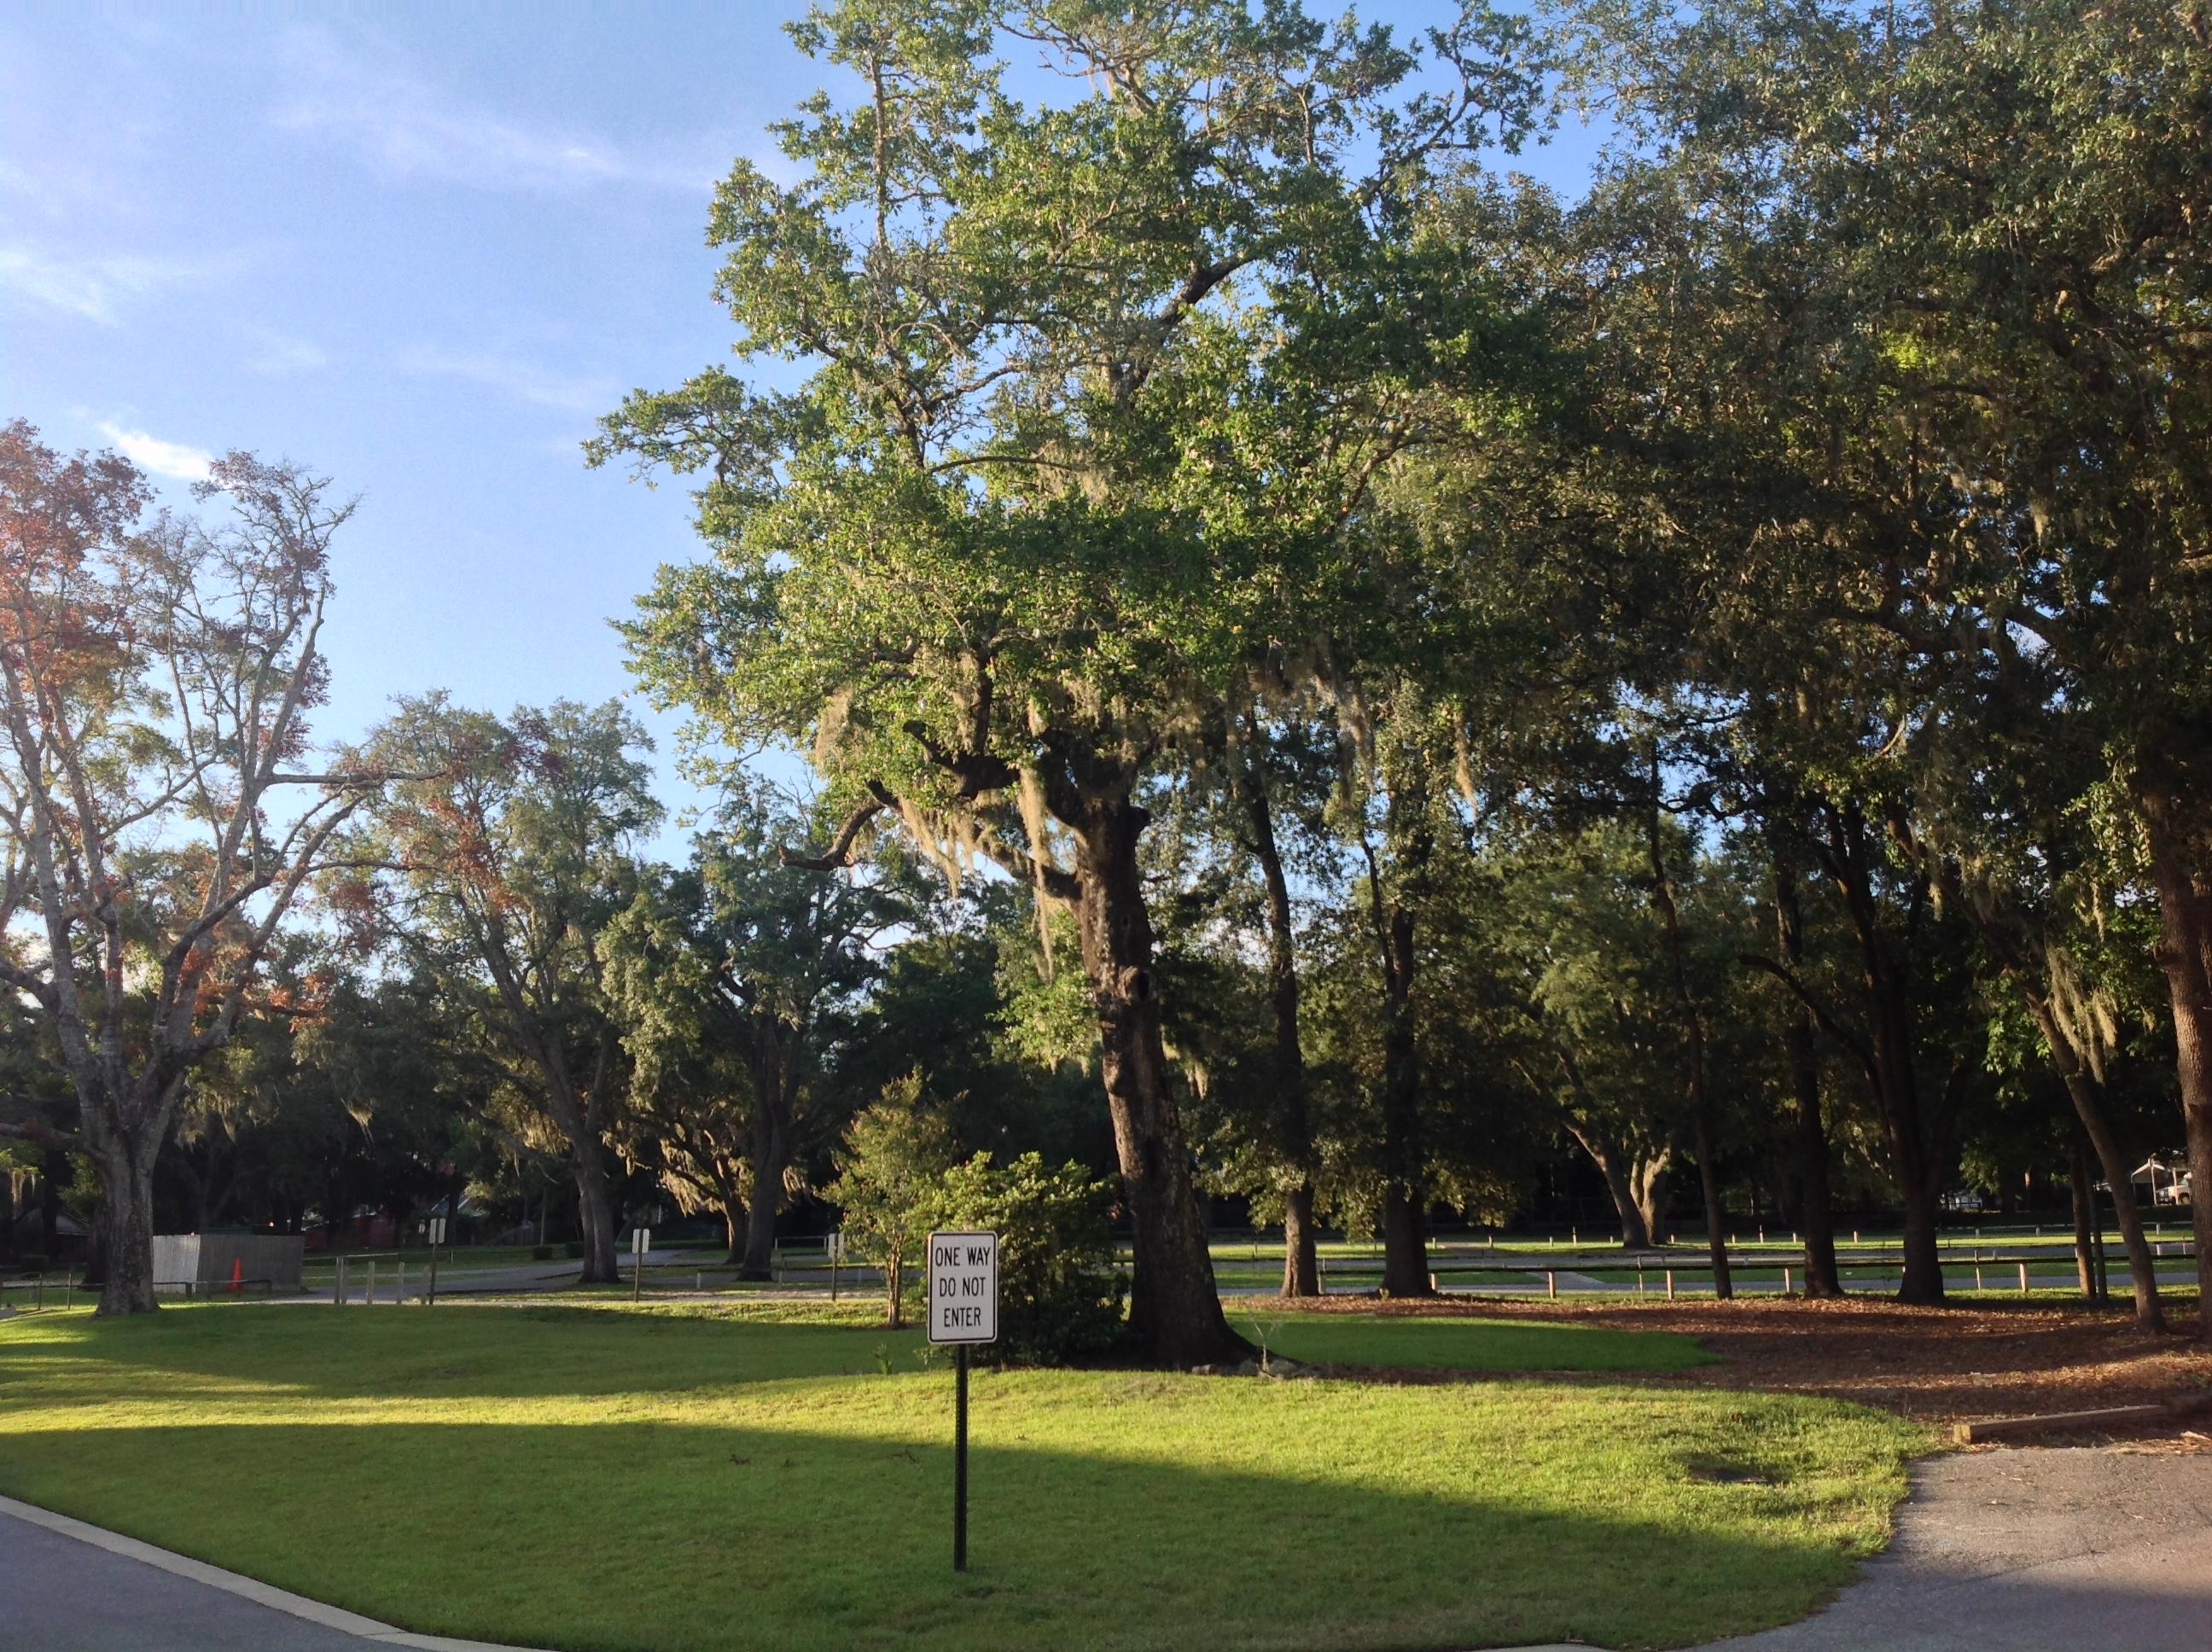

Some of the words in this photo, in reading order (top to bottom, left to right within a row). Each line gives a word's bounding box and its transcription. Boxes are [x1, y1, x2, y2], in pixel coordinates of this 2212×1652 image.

[935, 1247, 961, 1266] ONE
[967, 1247, 991, 1266] WAY
[940, 1277, 956, 1297] DO
[963, 1277, 986, 1296] NOT
[944, 1307, 981, 1327] ENTER
